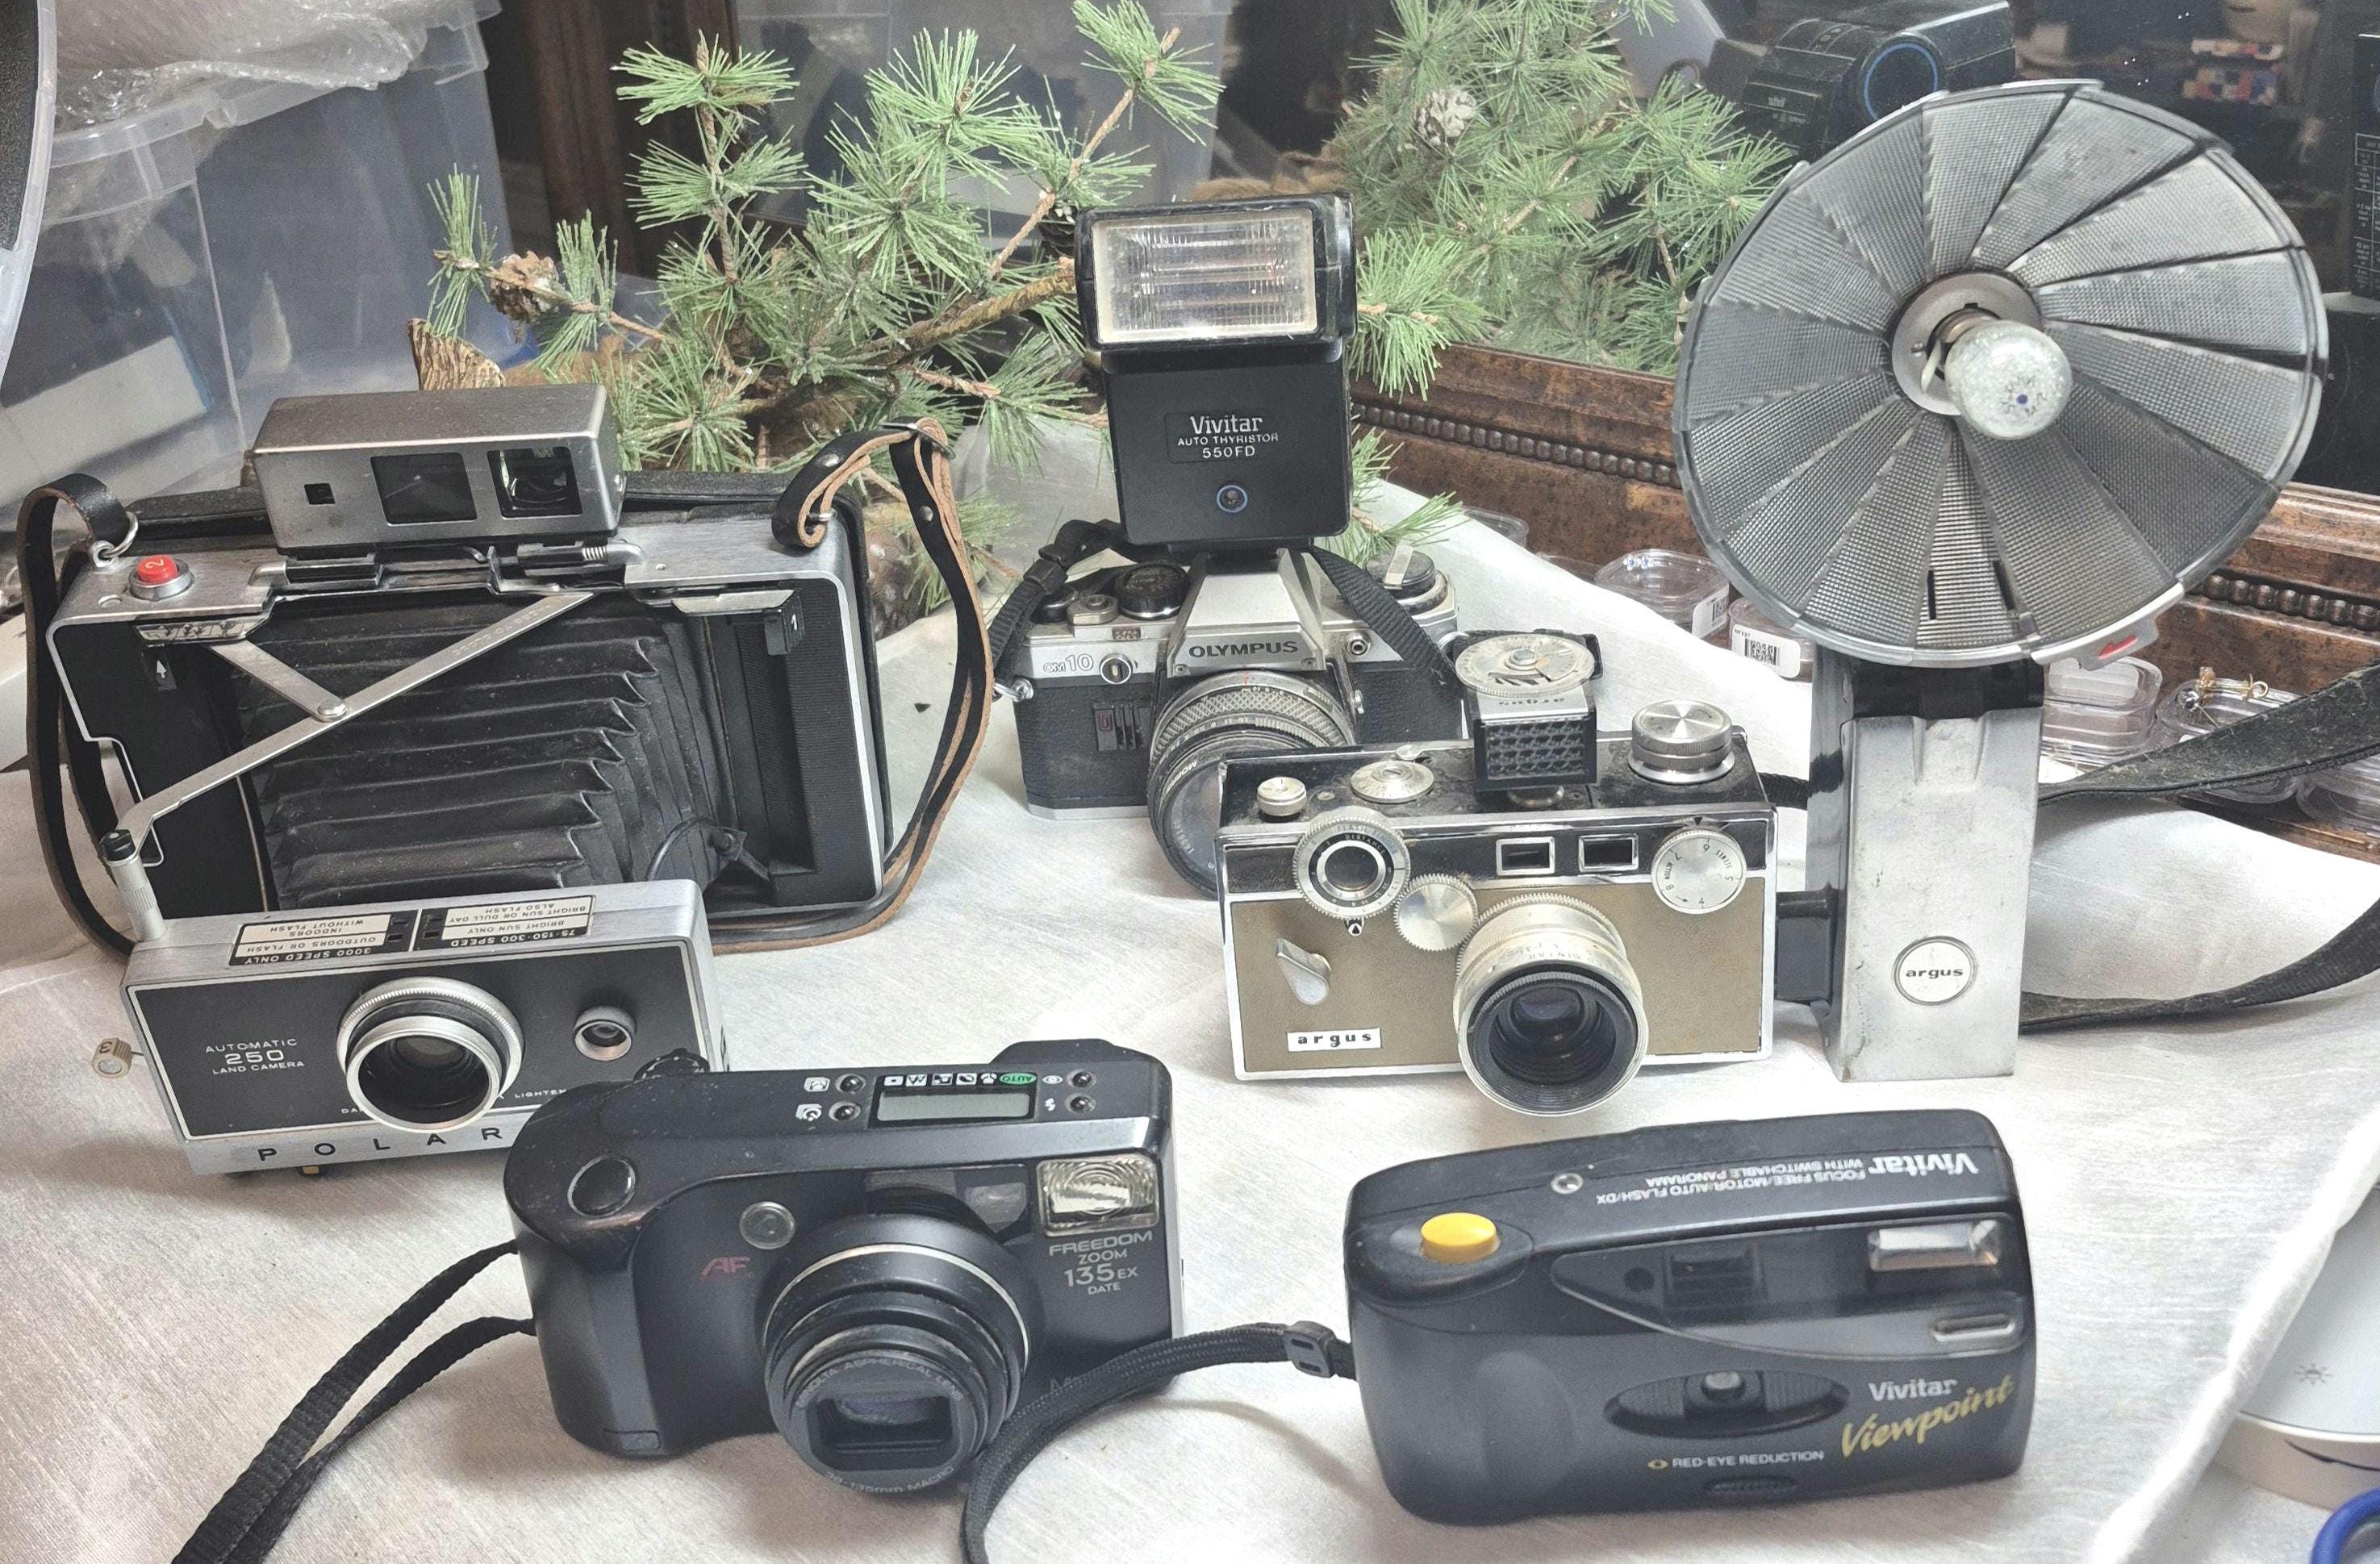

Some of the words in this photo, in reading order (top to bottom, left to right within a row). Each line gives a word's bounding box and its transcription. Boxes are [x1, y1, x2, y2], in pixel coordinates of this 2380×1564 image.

[1189, 414, 1263, 435] Vivitar
[1177, 436, 1209, 446] AUTO
[1213, 432, 1279, 444] THYRISTOR
[1202, 445, 1255, 459] 550FD
[1188, 640, 1299, 659] OLYMPUS
[485, 906, 523, 914] FLASH
[526, 903, 555, 911] ALSO
[548, 905, 586, 915] BRIGHT
[473, 913, 499, 922] DULL
[269, 924, 307, 933] FLASH
[312, 919, 364, 930] WITHOUT
[467, 926, 495, 934] ONLY
[526, 920, 565, 930] BRIGHT
[289, 927, 342, 936] INDOORS
[311, 936, 377, 948] OUTDOORS
[450, 936, 496, 948] SPEED
[247, 944, 284, 953] FLASH
[336, 947, 373, 956] 3000
[244, 955, 281, 965] ONLY
[285, 950, 331, 961] SPEED
[1905, 968, 1964, 980] argus
[205, 1038, 298, 1054] AUTOMATIC
[1297, 1033, 1372, 1048] argus
[223, 1049, 285, 1065] 250
[212, 1065, 247, 1075] LAND
[251, 1060, 306, 1072] CAMERA
[1001, 1074, 1033, 1082] AUTO
[257, 1127, 504, 1162] POLAR
[1824, 1158, 1864, 1170] WITH
[1868, 1152, 1980, 1177] Vivitar
[1645, 1170, 1727, 1188] PANORAMA
[1814, 1170, 1867, 1181] FOCUS
[1049, 1230, 1153, 1257] FREEDOM
[1078, 1248, 1128, 1266] ZOOM
[1088, 1281, 1121, 1295] DATE
[1868, 1378, 1959, 1402] Vivitar
[1841, 1374, 2015, 1458] Viewpoint
[1672, 1454, 1736, 1469] RED-EYE
[1738, 1450, 1826, 1466] REDUCTION
